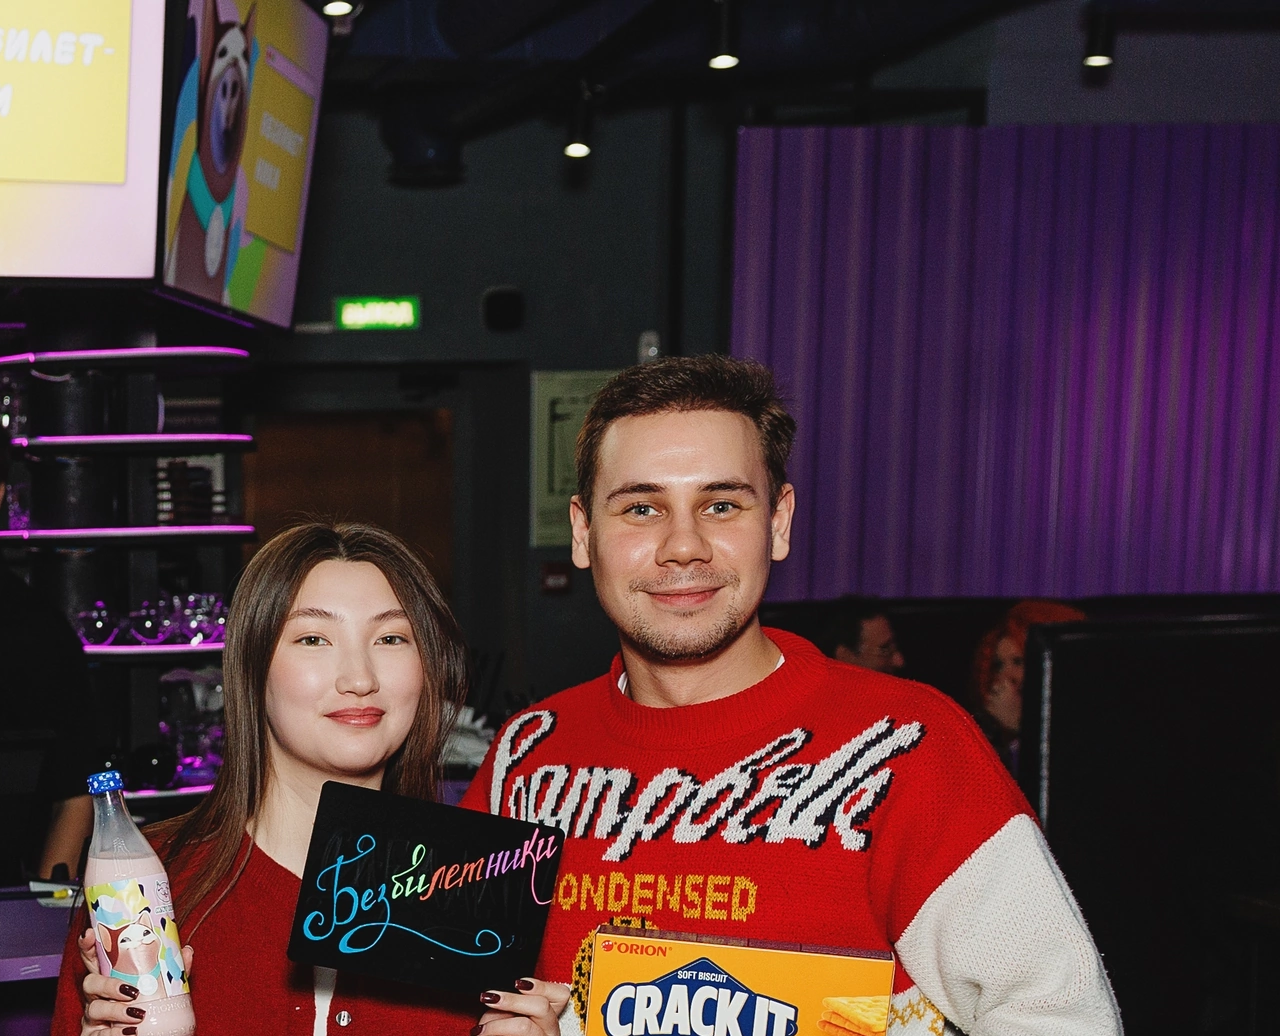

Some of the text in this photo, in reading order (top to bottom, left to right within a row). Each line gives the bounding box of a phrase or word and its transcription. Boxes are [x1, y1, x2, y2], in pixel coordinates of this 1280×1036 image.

[303, 828, 558, 956] Безбилетники
[554, 872, 759, 921] ONDENSED
[677, 970, 728, 983] SOFT BISCUIT
